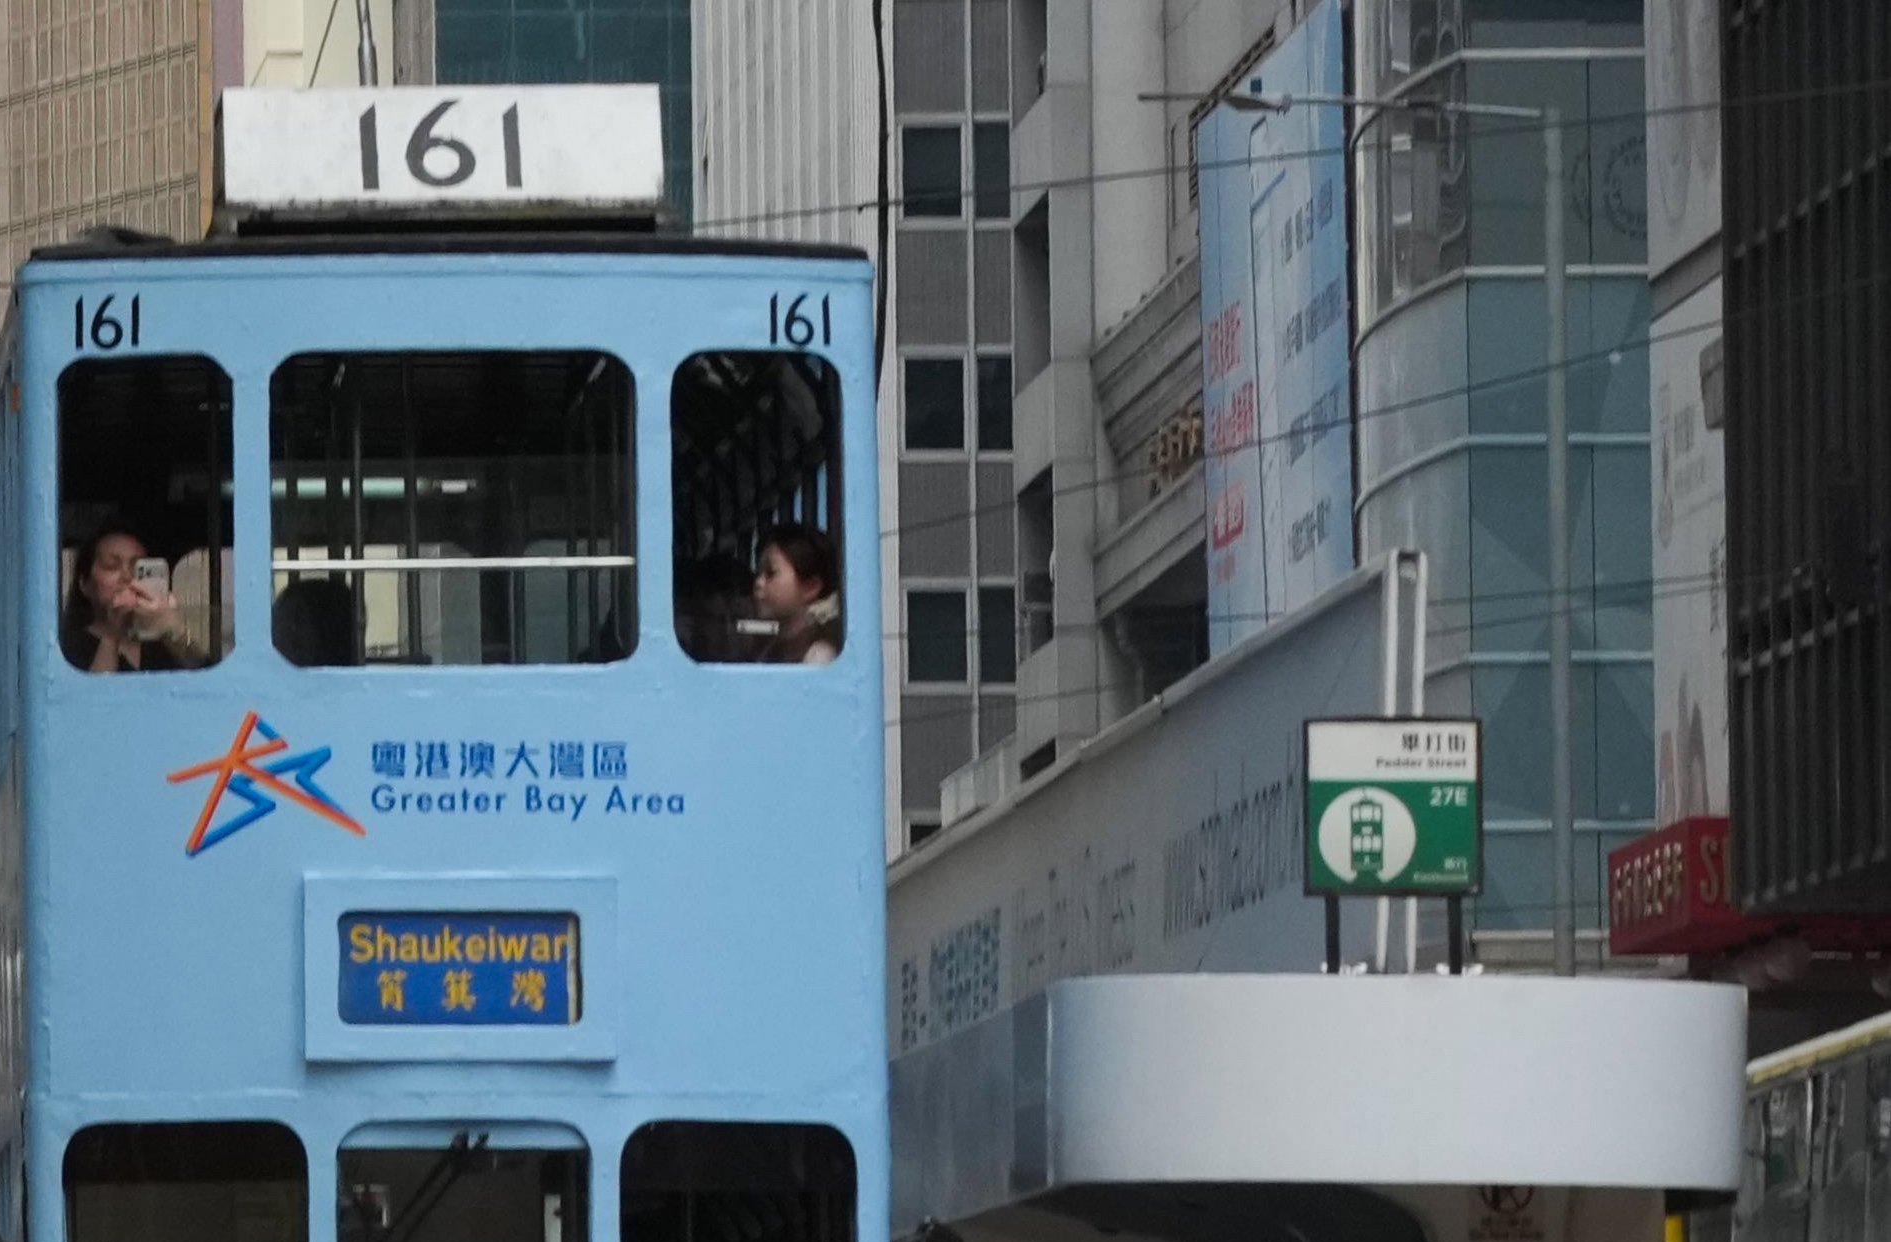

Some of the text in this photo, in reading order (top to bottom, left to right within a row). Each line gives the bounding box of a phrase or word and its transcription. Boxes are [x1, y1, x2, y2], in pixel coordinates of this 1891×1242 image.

[359, 97, 523, 190] 161
[75, 291, 139, 351] 161
[770, 291, 830, 347] 161
[371, 741, 628, 779] 粵港澳大灣區
[371, 783, 686, 821] Greater Bay Area
[1430, 786, 1468, 806] 27E
